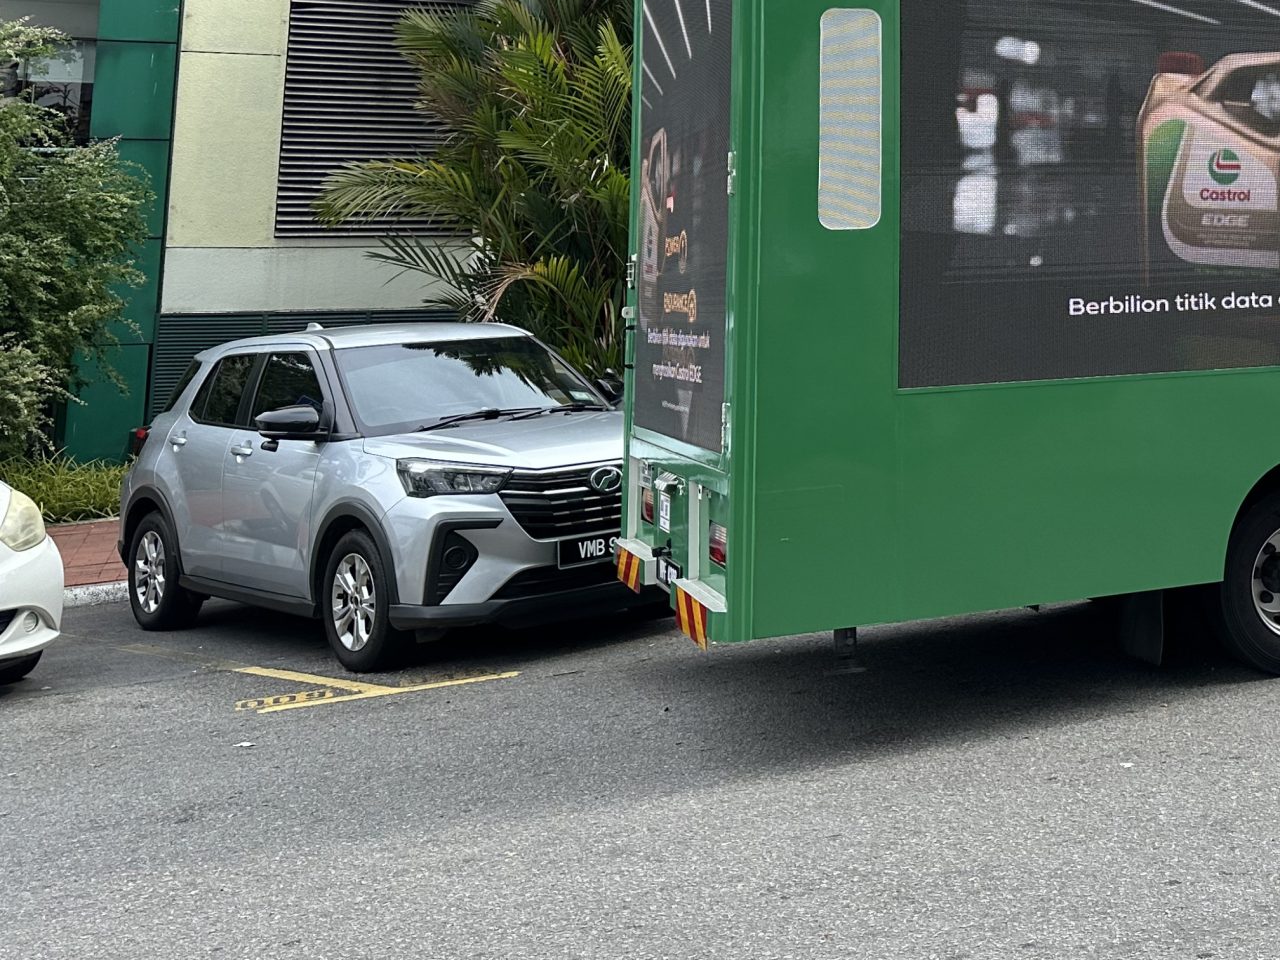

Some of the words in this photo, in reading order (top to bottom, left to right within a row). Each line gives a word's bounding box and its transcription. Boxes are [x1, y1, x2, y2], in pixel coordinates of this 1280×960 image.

[1199, 187, 1251, 202] Castrol
[1201, 213, 1250, 227] EDGE
[1068, 295, 1170, 316] Berbilion
[1174, 292, 1217, 311] titik
[1221, 291, 1273, 309] data
[578, 538, 606, 559] VMB
